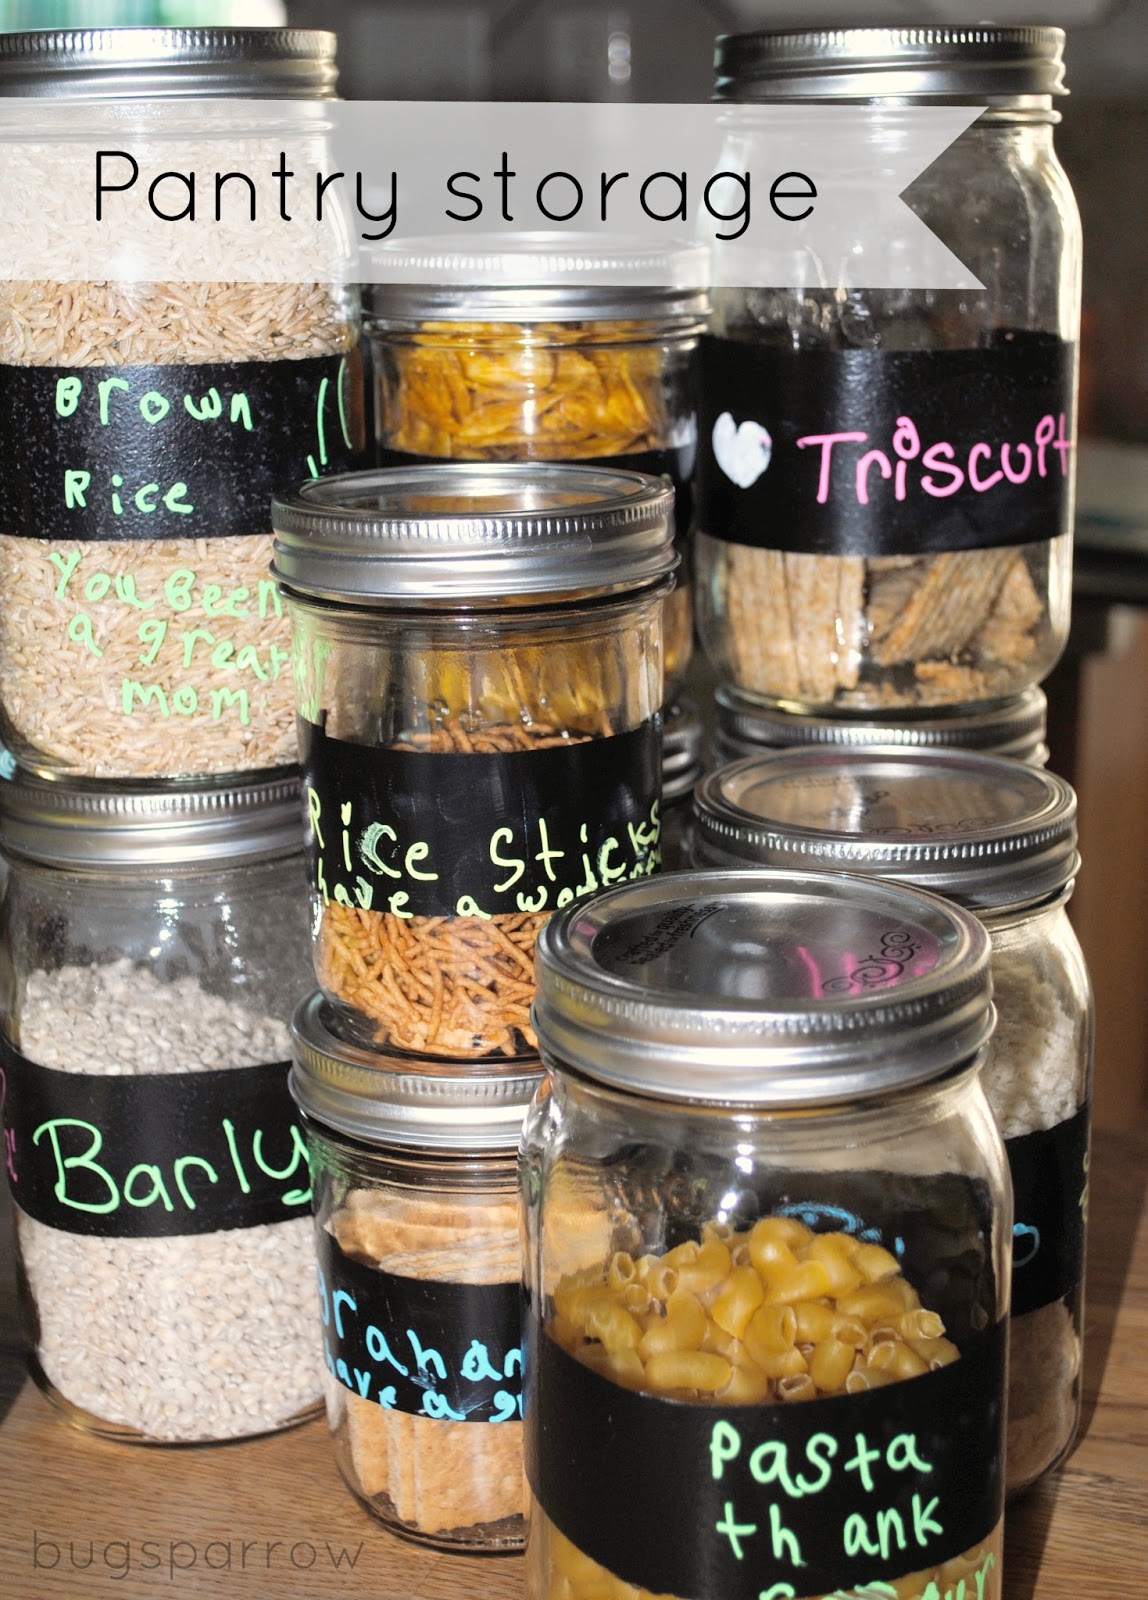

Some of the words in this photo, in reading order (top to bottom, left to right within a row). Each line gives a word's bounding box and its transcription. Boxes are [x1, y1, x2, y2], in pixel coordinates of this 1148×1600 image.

[55, 376, 253, 431] Brown
[796, 412, 1073, 505] Triscuit
[63, 469, 195, 515] Rice
[48, 550, 155, 609] You
[306, 787, 439, 881] Rice
